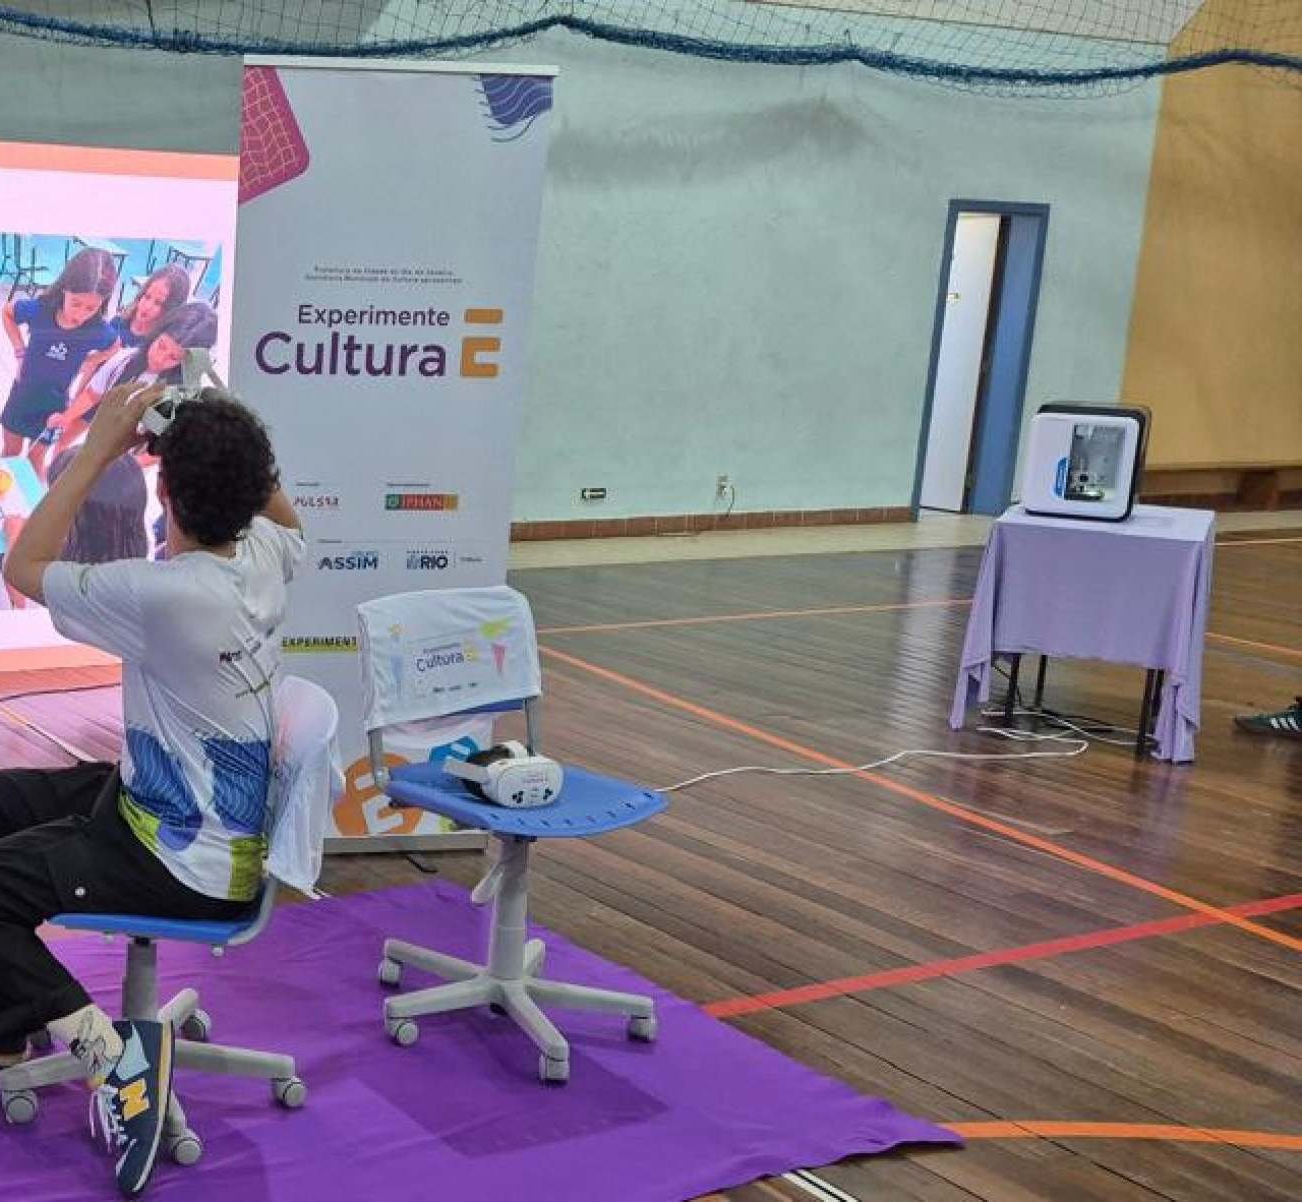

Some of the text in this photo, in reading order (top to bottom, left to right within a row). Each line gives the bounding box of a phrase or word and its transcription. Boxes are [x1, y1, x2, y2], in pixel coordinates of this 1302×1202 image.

[298, 304, 450, 328] Experimente
[255, 331, 447, 377] Cultura
[318, 556, 378, 571] ASSIM
[420, 555, 449, 570] RIO
[415, 651, 465, 673] Cultura
